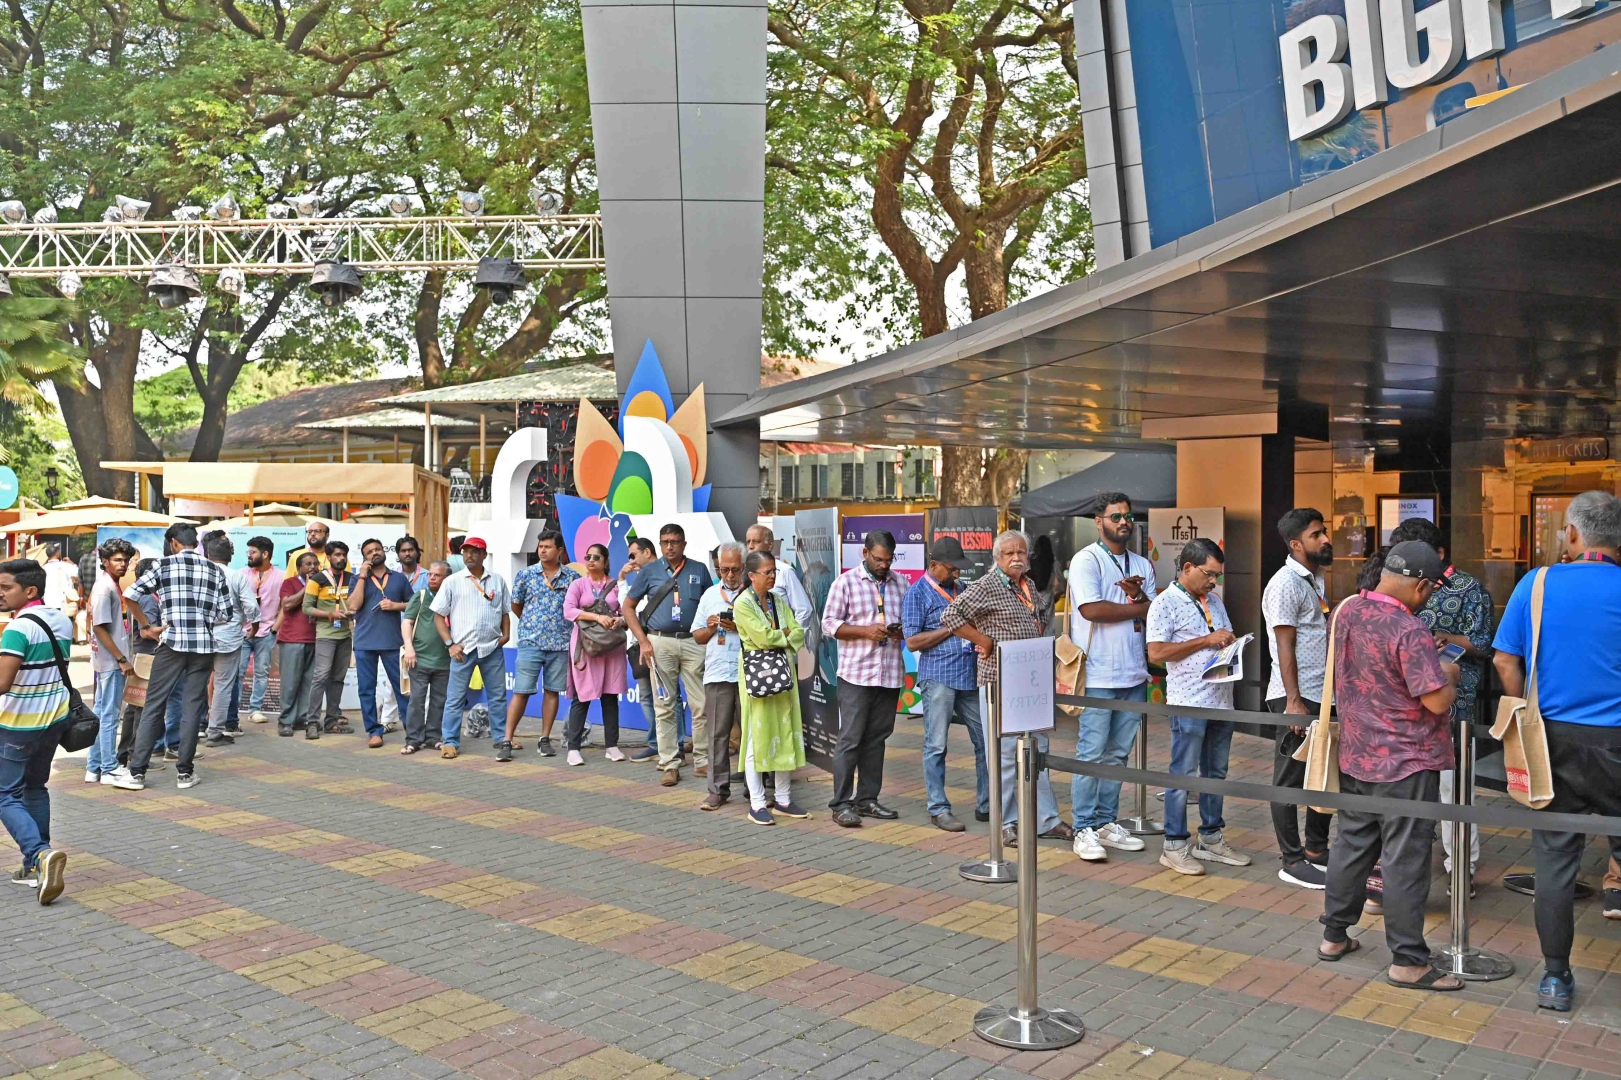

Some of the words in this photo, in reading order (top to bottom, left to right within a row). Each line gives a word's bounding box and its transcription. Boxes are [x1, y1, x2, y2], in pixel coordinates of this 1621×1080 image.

[1556, 442, 1601, 458] TICKETS
[961, 531, 993, 550] LESSON
[1180, 531, 1189, 540] 55
[628, 683, 640, 703] of
